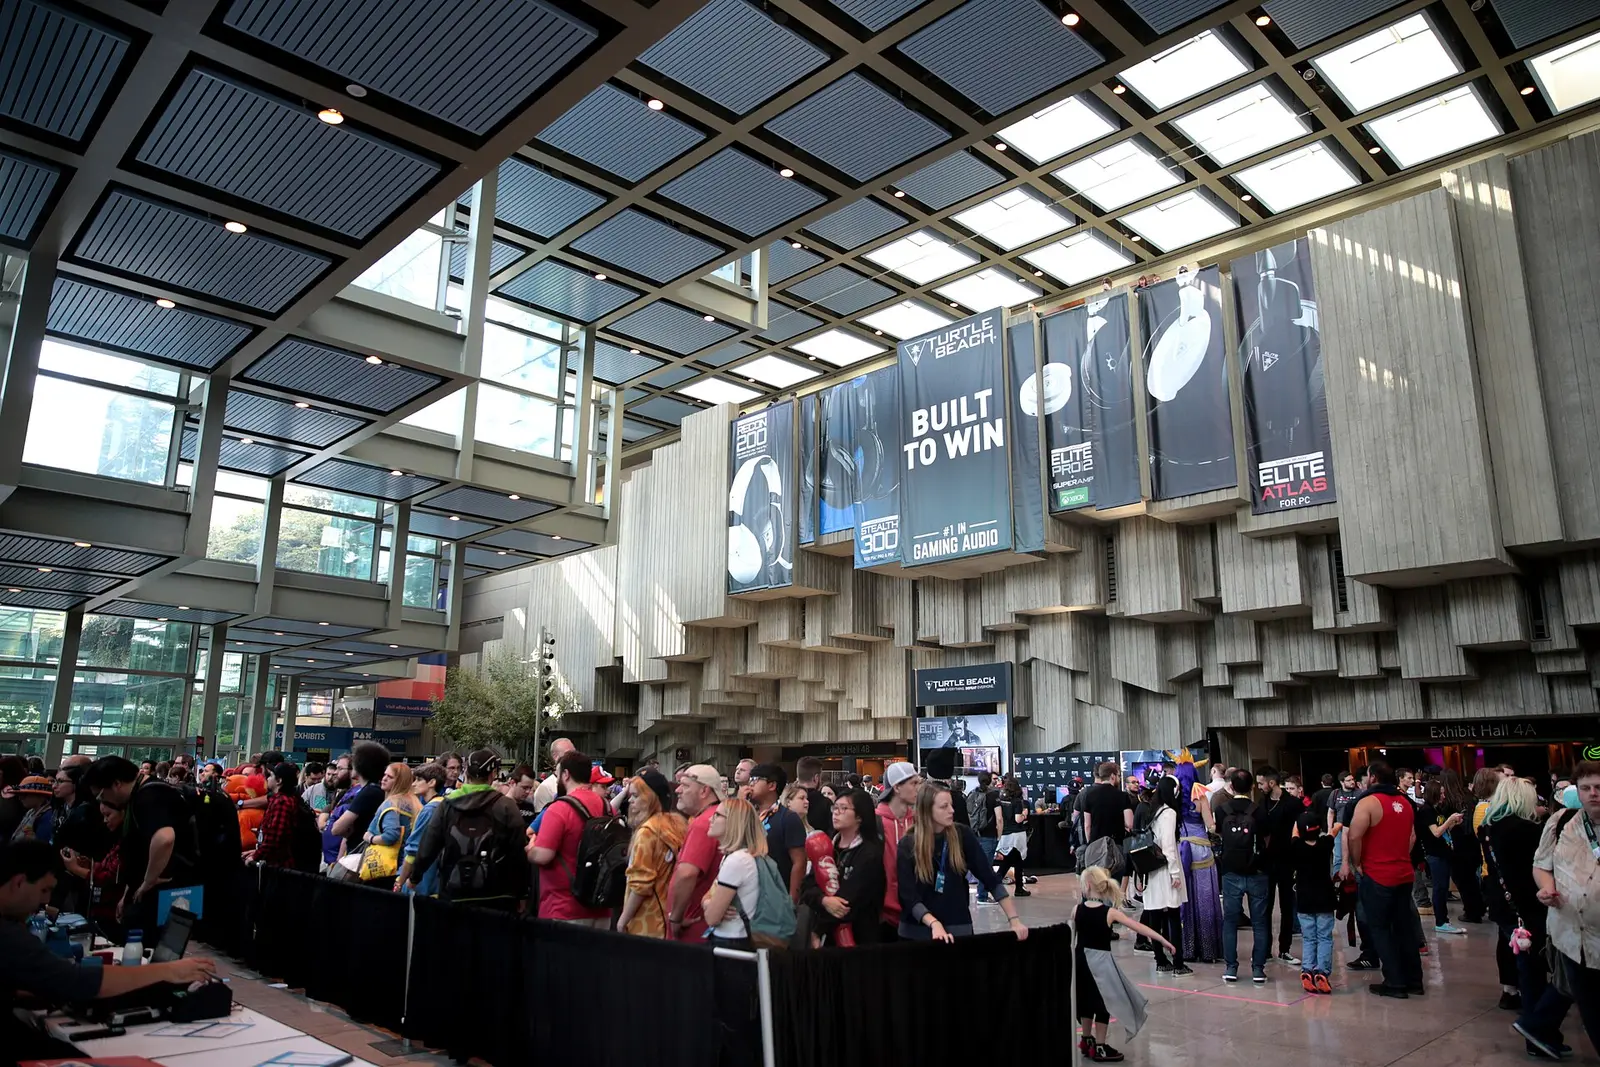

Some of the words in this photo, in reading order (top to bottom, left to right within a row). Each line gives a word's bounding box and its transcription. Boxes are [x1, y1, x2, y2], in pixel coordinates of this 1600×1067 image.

[926, 316, 993, 353] TURTLE
[935, 328, 994, 360] BEACH
[912, 388, 993, 437] BUILT
[737, 417, 767, 436] RECON
[736, 427, 767, 452] 200
[903, 437, 937, 470] TO
[944, 418, 1004, 460] WIN
[1051, 446, 1092, 466] ELITE
[1052, 461, 1080, 477] PRO
[1083, 459, 1093, 471] 2
[1258, 458, 1326, 487] ELITE
[1053, 476, 1094, 489] SUPERAMP
[1262, 477, 1328, 501] ATLAS
[1279, 499, 1296, 508] FOR
[1298, 496, 1311, 505] PC
[861, 520, 898, 535] STEALTH
[943, 524, 954, 536] #1
[957, 521, 967, 534] IN
[861, 529, 898, 555] 300
[913, 537, 958, 560] GAMING
[962, 528, 998, 551] AUDIO
[933, 679, 965, 690] TURTLE
[966, 676, 996, 686] BEACH
[51, 723, 66, 733] EXIT
[294, 731, 326, 740] EXHIBITS
[920, 724, 943, 733] ELITE
[1430, 725, 1476, 738] Exhibit
[1481, 724, 1509, 736] Hall
[1513, 723, 1537, 735] 4A
